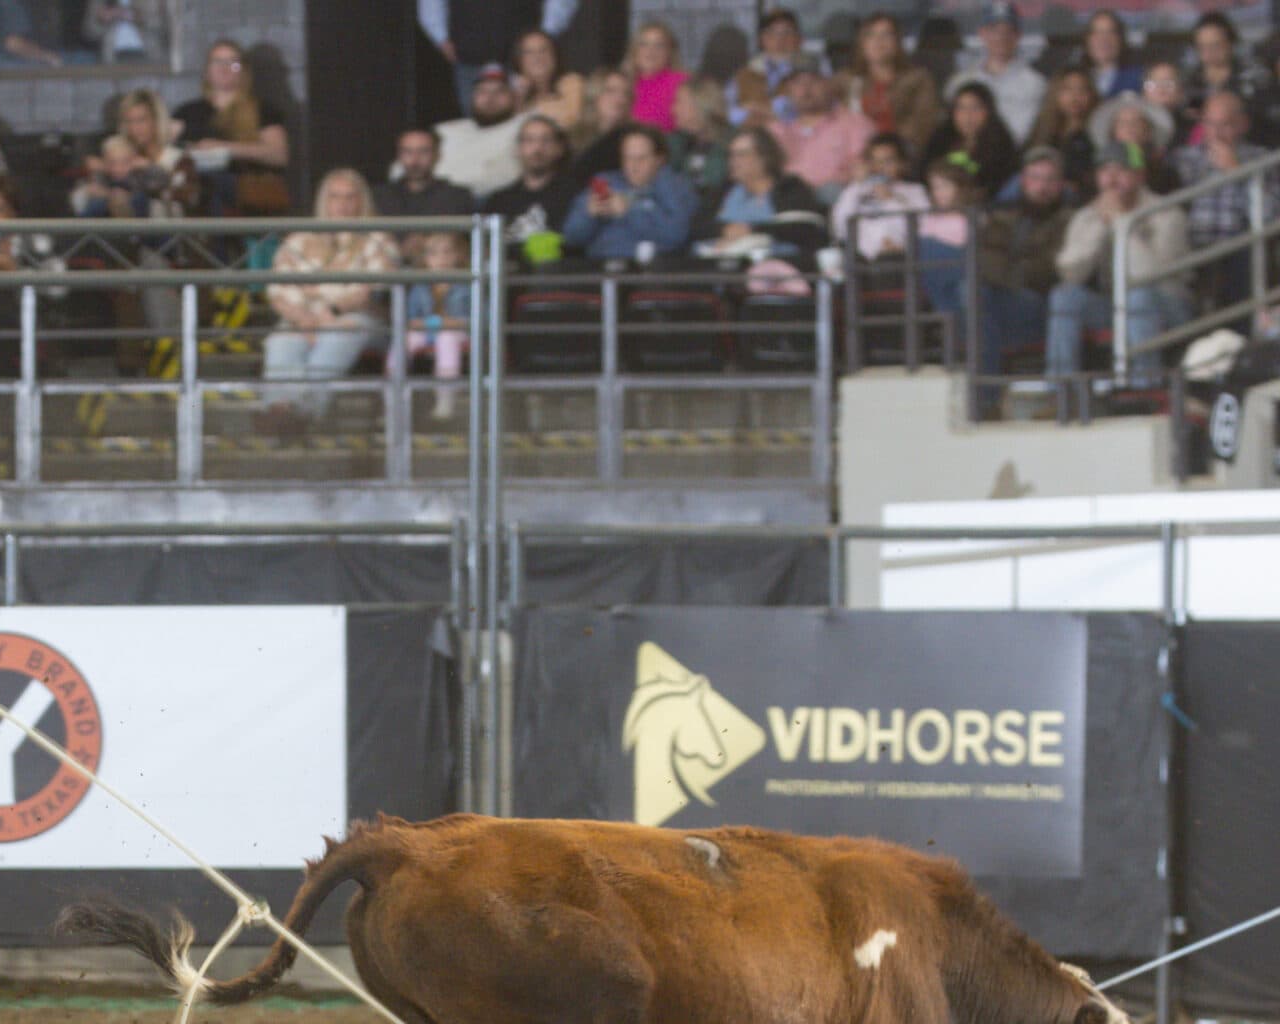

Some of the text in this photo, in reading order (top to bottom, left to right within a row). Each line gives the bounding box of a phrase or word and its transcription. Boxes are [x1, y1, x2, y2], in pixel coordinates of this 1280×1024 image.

[25, 648, 97, 737] BRAND
[766, 706, 1065, 768] VIDHORSE
[18, 775, 80, 828] TEXAS
